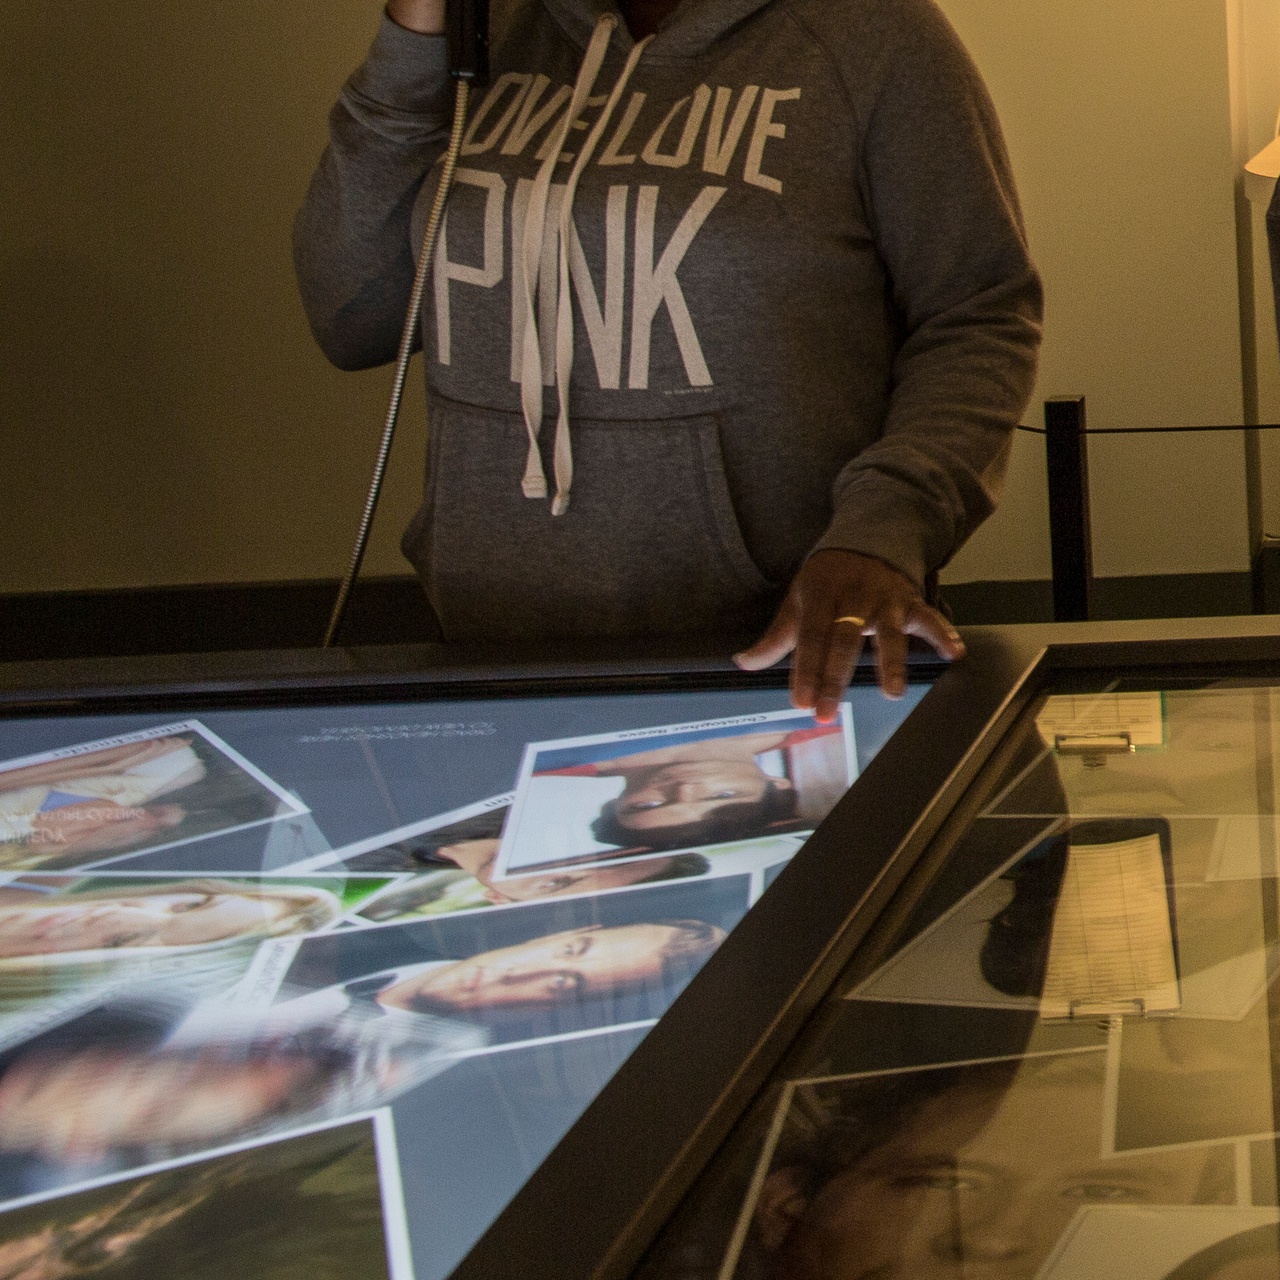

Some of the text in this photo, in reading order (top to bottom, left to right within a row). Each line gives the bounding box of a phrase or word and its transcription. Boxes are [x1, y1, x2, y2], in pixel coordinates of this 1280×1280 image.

[440, 71, 801, 195] OVE LOVE
[434, 166, 728, 391] PINK
